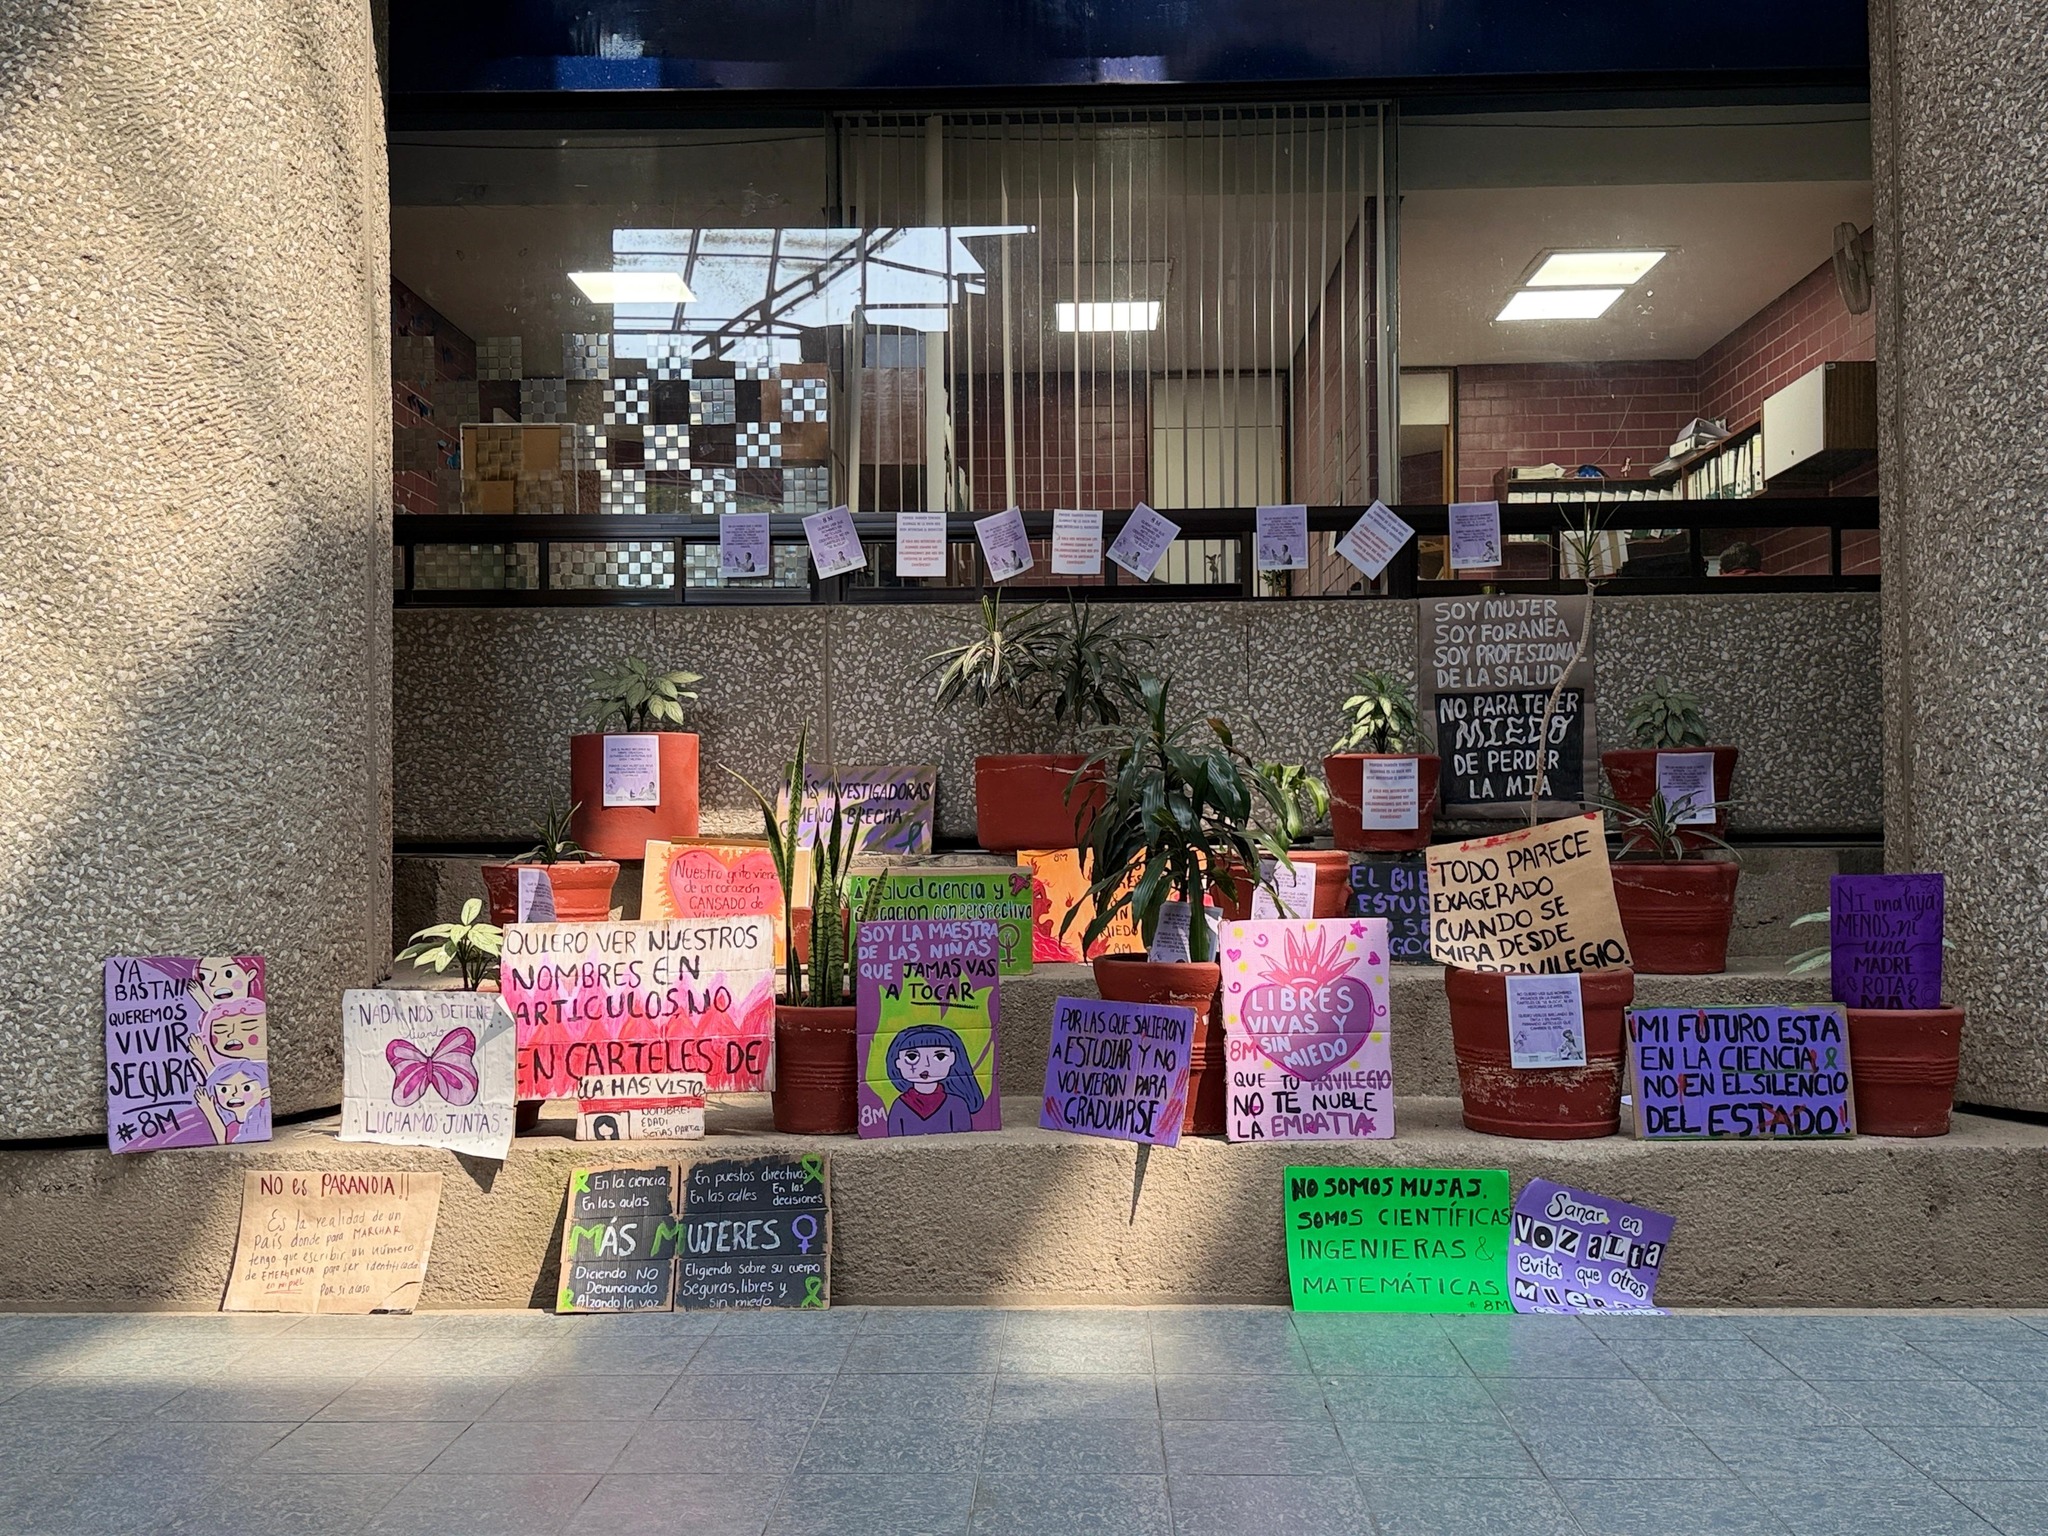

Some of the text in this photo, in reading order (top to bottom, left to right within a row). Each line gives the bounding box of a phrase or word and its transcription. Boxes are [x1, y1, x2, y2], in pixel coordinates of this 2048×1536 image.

[1434, 599, 1558, 622] SOY MUJER
[1433, 618, 1570, 645] SOY FORANEA
[1432, 646, 1474, 668] SOY
[1437, 664, 1565, 689] DE LA SALUD
[1440, 694, 1521, 724] NO PARA
[1454, 752, 1479, 776] DE
[1469, 777, 1495, 799] LA
[1432, 830, 1592, 887] TODO PARECE
[1352, 865, 1380, 888] EL
[928, 881, 1005, 900] ciencia y
[1433, 876, 1553, 913] EXAGERADO
[689, 895, 764, 911] CANSADO de
[933, 904, 957, 921] con
[1903, 885, 1936, 921] hija
[1436, 910, 1533, 943] CUANDO
[1541, 896, 1569, 921] SE
[507, 925, 758, 955] QUIERO VER NUESTROS
[861, 921, 999, 943] SOY LA MAESTRA
[1435, 922, 1575, 963] MIRA DESDE
[858, 938, 991, 961] DE LAS NIÑAS
[512, 955, 699, 992] NOMBRES EN
[861, 958, 997, 980] QUE JAMAS VAS
[1853, 956, 1916, 975] MADRE
[114, 960, 185, 1001] YA BASTA!!
[885, 983, 975, 1001] A TOCAR
[1863, 976, 1907, 996] ROTA
[688, 986, 732, 1016] NO
[1251, 985, 1355, 1014] LIBRES
[109, 1004, 187, 1027] QUEREMOS
[359, 1003, 494, 1027] NADA NOS DETIENE
[1060, 1007, 1186, 1044] POR LAS QUE SALIERON
[1247, 1014, 1348, 1036] VIVAS Y
[115, 1022, 190, 1054] VIVIR
[1678, 1011, 1841, 1046] FUTURO ESTÁ
[1052, 1036, 1176, 1072] A ESTUDIAR Y NO
[1230, 1039, 1258, 1062] 8M
[1260, 1036, 1291, 1053] SIN
[1284, 1037, 1348, 1069] MIEDO
[565, 1039, 763, 1079] CARTELES DE
[1641, 1046, 1711, 1071] EN LA
[110, 1056, 207, 1103] SEGURAS
[611, 1076, 651, 1096] HAS
[1057, 1070, 1167, 1100] VOLVIERON PARA
[1234, 1069, 1391, 1092] QUE TU PRIVILEGIO
[1644, 1071, 1849, 1099] NO EN EL SILENCIO
[861, 1105, 888, 1127] 8M
[1234, 1091, 1378, 1117] NO TE NUBLE
[117, 1108, 180, 1144] #8M
[366, 1110, 500, 1135] LUCHAMOS JUNTAS
[1064, 1096, 1160, 1137] GRADUARSE
[1646, 1100, 1851, 1137] DEL ESTADO!
[1237, 1118, 1265, 1140] LA
[260, 1174, 308, 1197] NO es
[595, 1175, 667, 1190] En la ciencia
[695, 1166, 808, 1189] En puestos directivos
[1291, 1177, 1394, 1201] NO SOMOS
[582, 1195, 650, 1211] En las aulas
[690, 1188, 758, 1204] En las calles
[772, 1193, 824, 1206] decisiones
[267, 1206, 384, 1233] Es la realidad de
[1297, 1201, 1512, 1230] SOMOS CIENTÍFICAS
[1546, 1193, 1640, 1233] Sanar en
[290, 1225, 401, 1249] donde MARCHAR
[570, 1216, 781, 1257] MÁS MUJERES
[248, 1243, 414, 1269] tengo que escribir número
[1300, 1236, 1495, 1262] INGENIERAS &
[261, 1266, 314, 1281] EMERGENCIA
[575, 1266, 659, 1280] Diciendo NO
[685, 1262, 820, 1281] Eligiendo cuerpo
[1519, 1254, 1561, 1277] evita
[1577, 1269, 1600, 1288] que
[1611, 1269, 1647, 1299] otras
[586, 1281, 658, 1295] Denunciando
[683, 1279, 774, 1300] Seguras, libres
[1303, 1272, 1500, 1296] MATEMÁTICAS
[576, 1295, 660, 1309] Alzando voz
[709, 1295, 772, 1308] sin miedo
